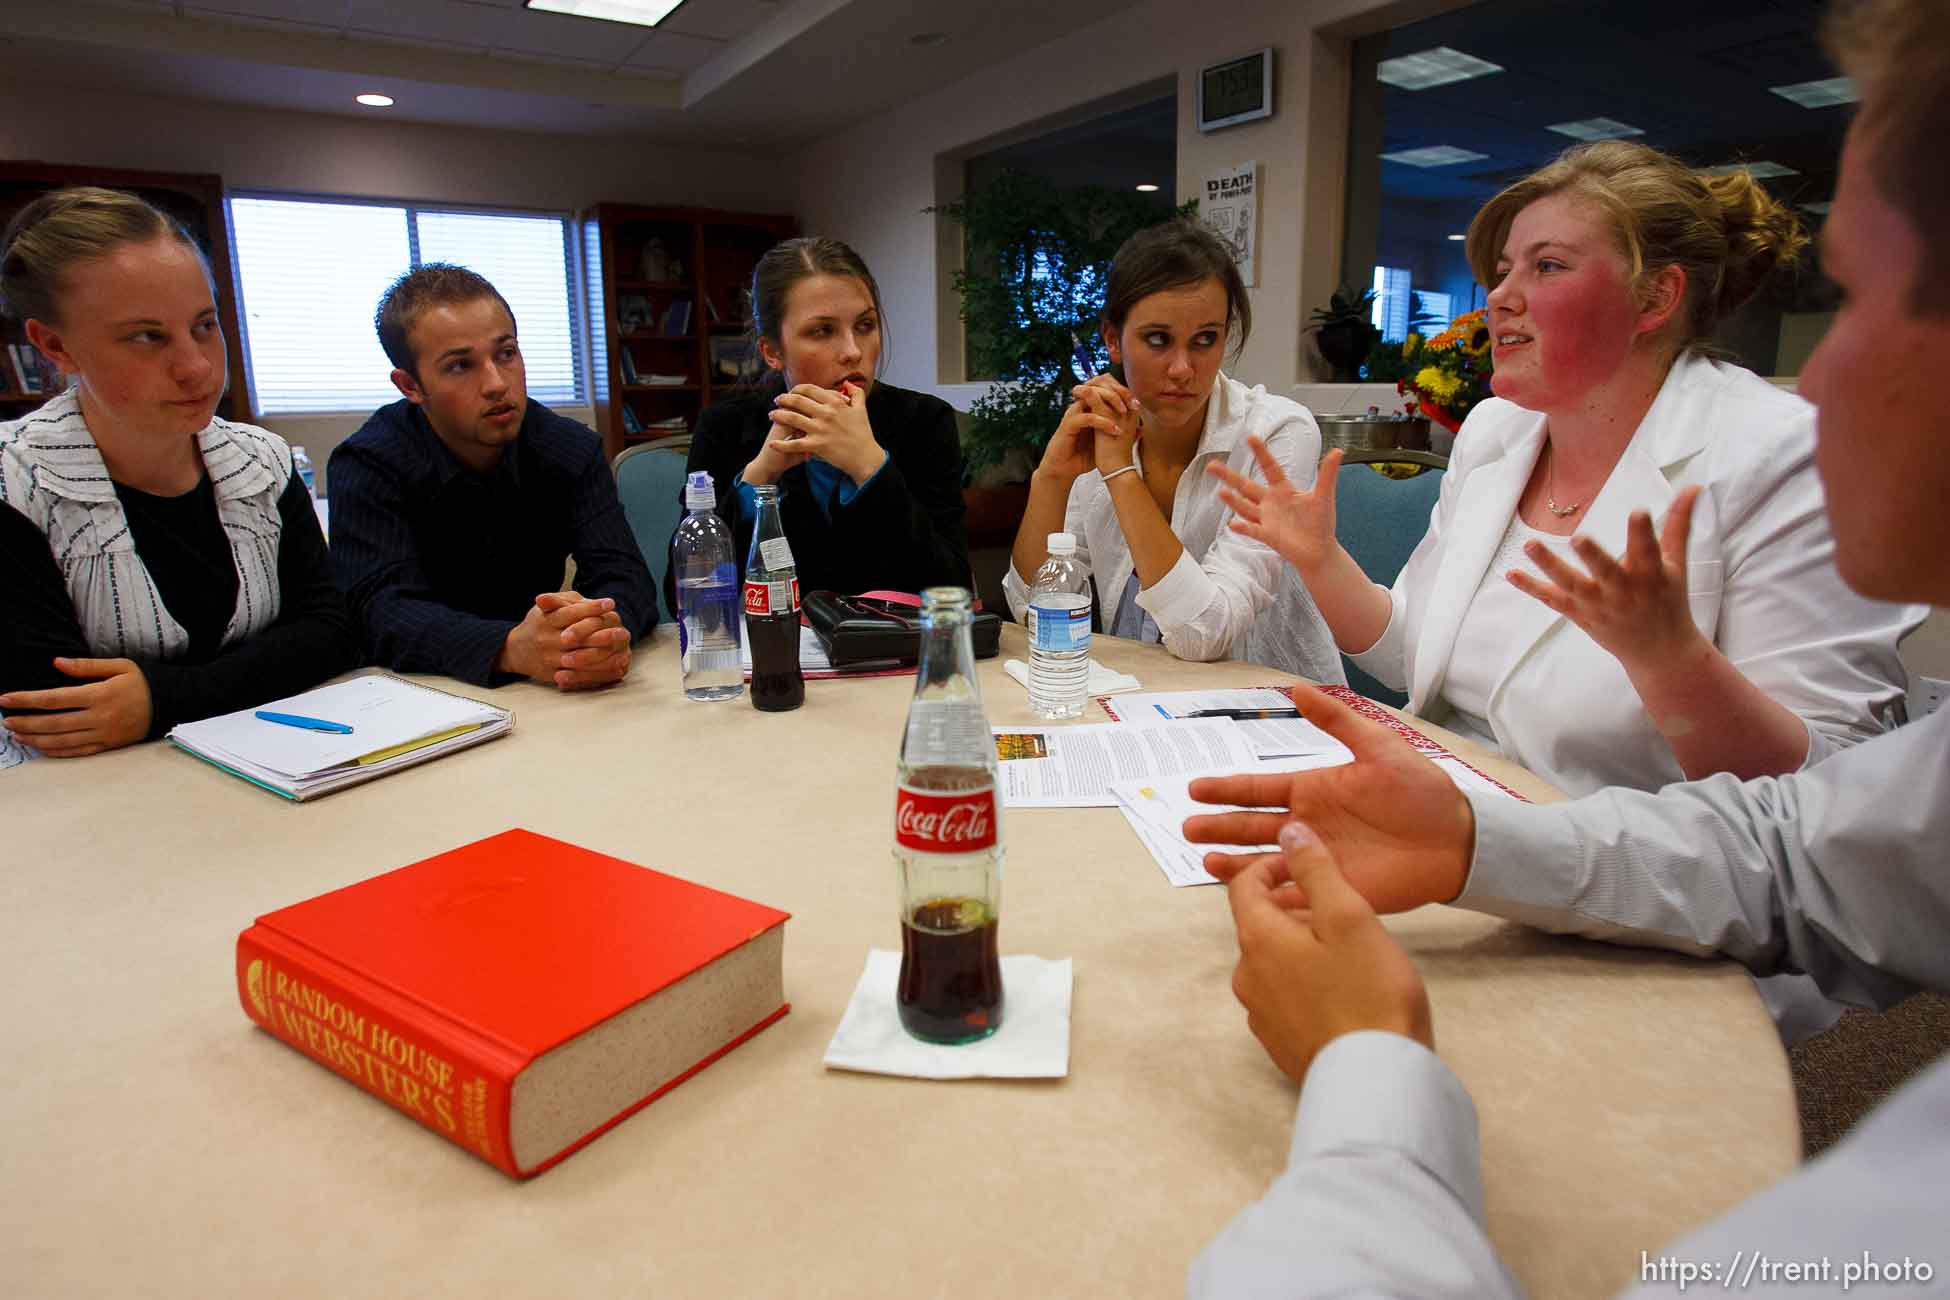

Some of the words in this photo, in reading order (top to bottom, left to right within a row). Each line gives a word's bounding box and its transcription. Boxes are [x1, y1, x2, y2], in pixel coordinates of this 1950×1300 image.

[1207, 172, 1252, 191] DEATH
[897, 799, 988, 842] Coca-Cola
[275, 971, 364, 1041] RANDOM
[370, 1023, 455, 1094] HOUSE
[278, 1001, 456, 1132] WEBSTER'S
